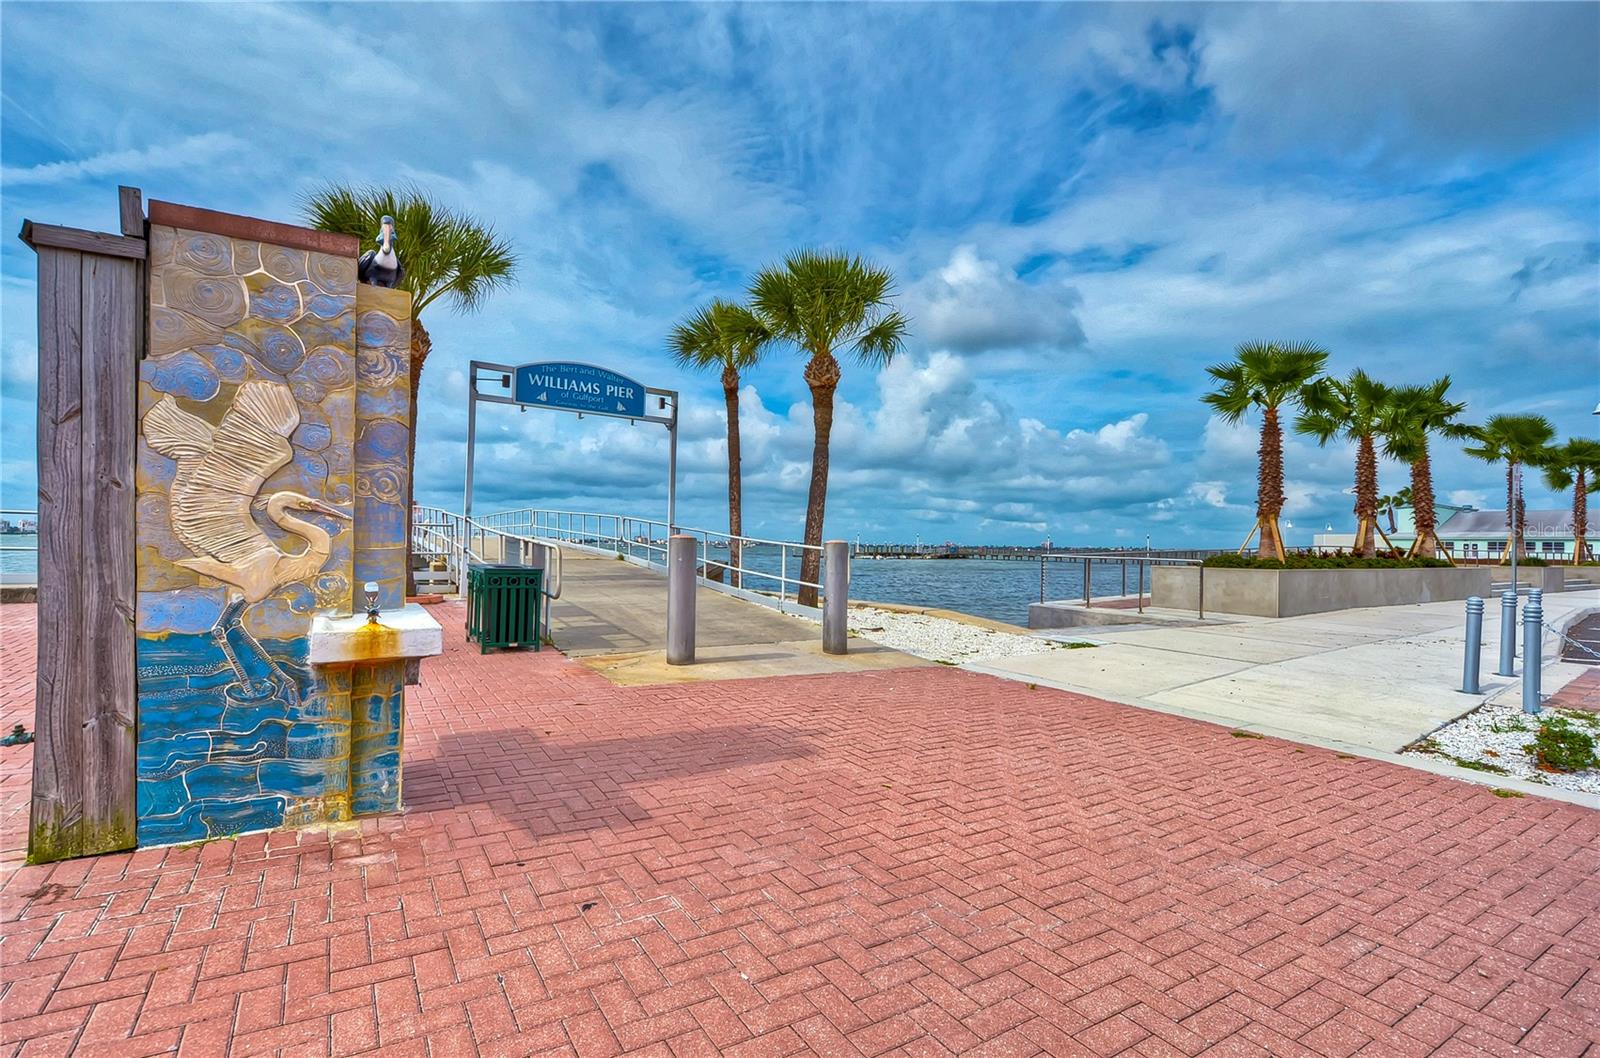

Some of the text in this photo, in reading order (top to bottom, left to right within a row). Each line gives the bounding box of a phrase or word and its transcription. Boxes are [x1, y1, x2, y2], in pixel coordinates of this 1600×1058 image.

[541, 364, 624, 384] The Bert and Walter
[528, 372, 634, 400] WILLIAMS PIER
[560, 390, 605, 403] of Gulfport
